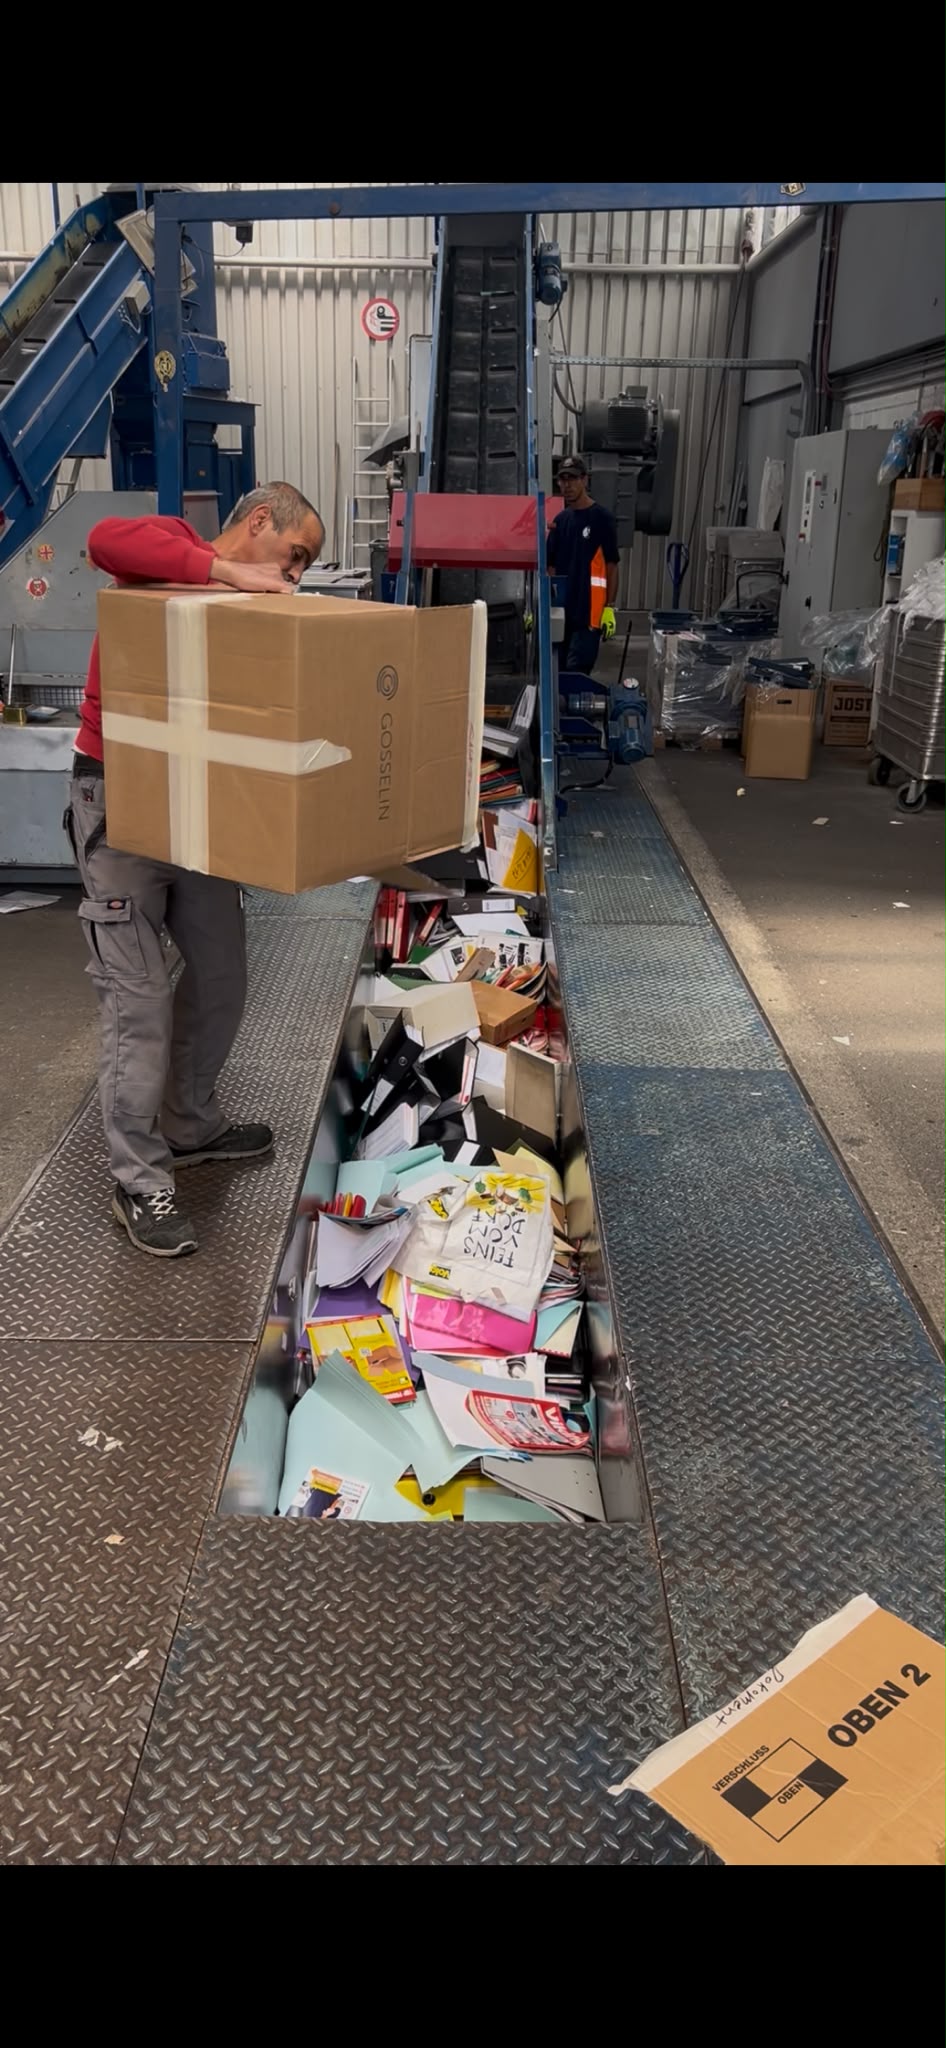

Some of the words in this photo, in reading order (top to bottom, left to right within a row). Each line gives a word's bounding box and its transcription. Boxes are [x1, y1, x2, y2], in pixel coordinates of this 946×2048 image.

[377, 712, 393, 821] GOSSELIN
[468, 1223, 519, 1248] VOM
[827, 1680, 909, 1748] OBEN
[900, 1663, 932, 1687] 2
[712, 1744, 771, 1793] VERSCHLUSS
[777, 1780, 805, 1806] OBEN
